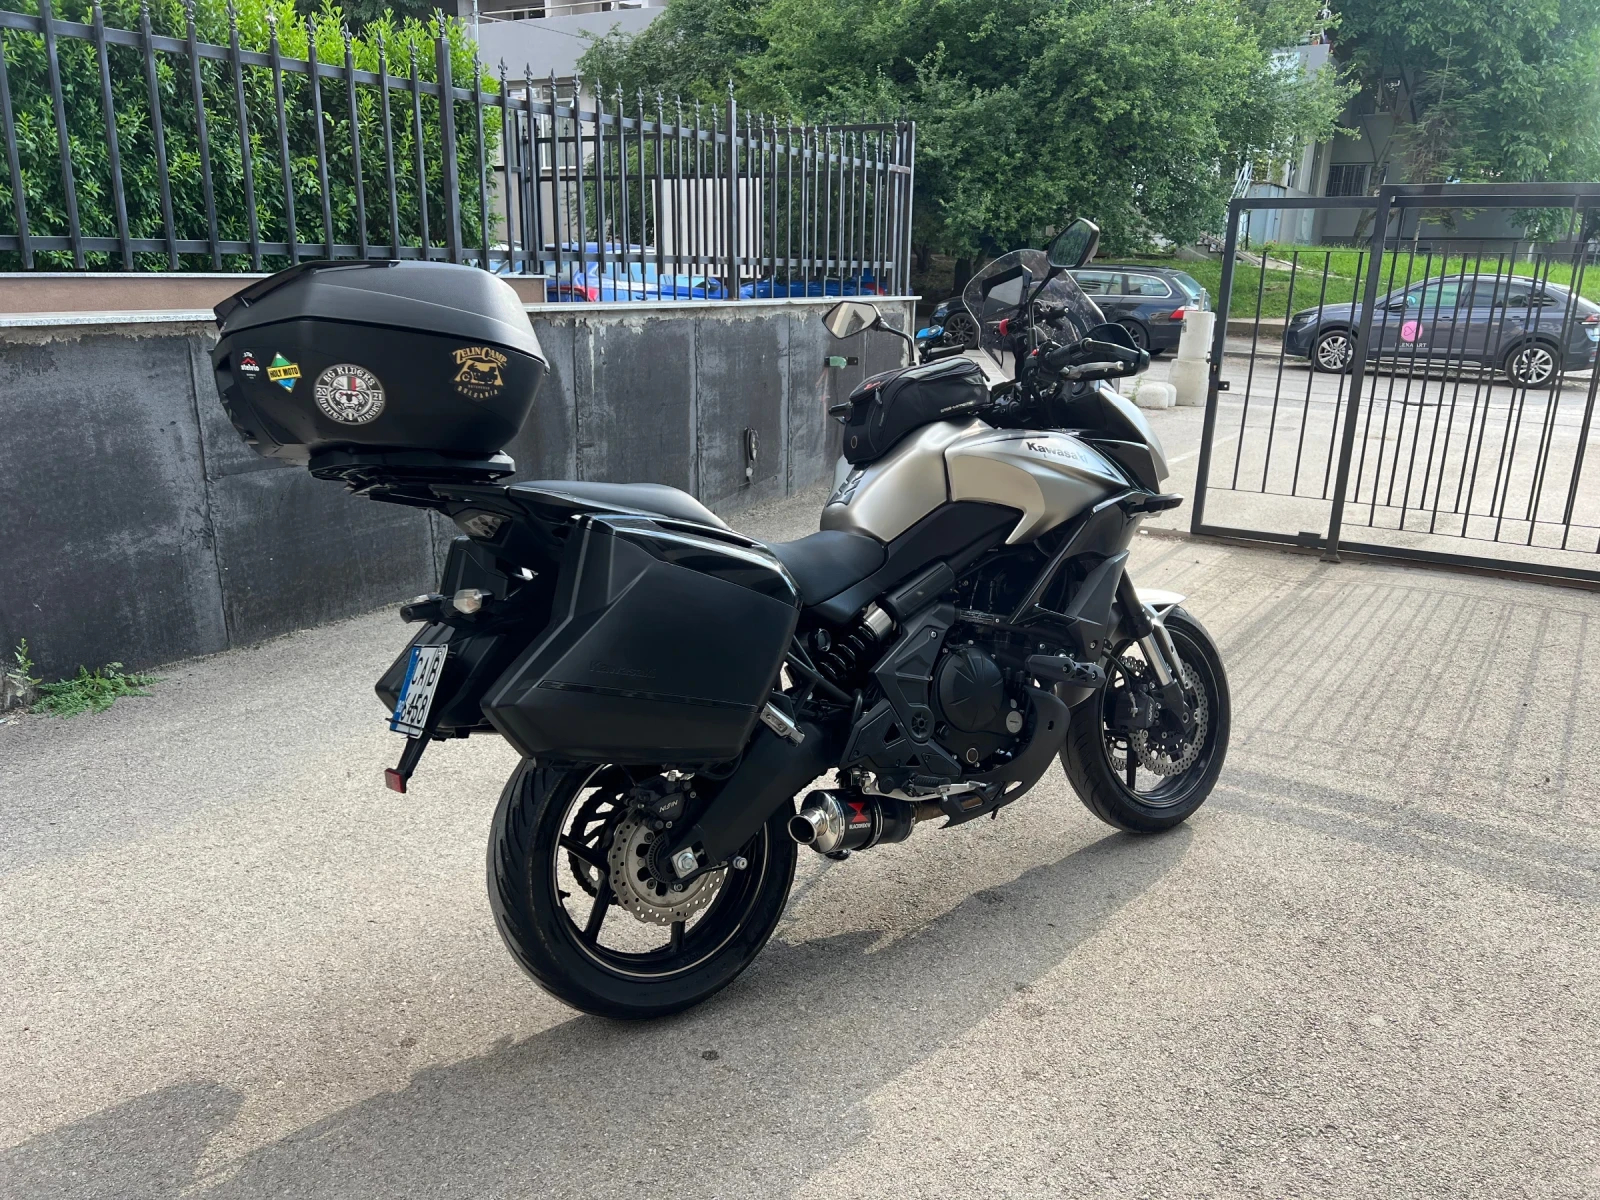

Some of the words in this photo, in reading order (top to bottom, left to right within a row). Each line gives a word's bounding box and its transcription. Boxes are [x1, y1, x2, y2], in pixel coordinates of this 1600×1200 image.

[452, 346, 481, 365] ZELIN
[481, 347, 508, 367] CAMP
[270, 369, 282, 378] HOLY
[282, 366, 299, 377] MOTO
[336, 366, 376, 386] RIDERS
[316, 387, 327, 396] 20
[372, 393, 382, 401] 21
[457, 385, 498, 399] BULGARIA
[1026, 441, 1089, 464] Kawasaki
[589, 660, 657, 679] Kawasaki
[400, 692, 429, 725] 6458
